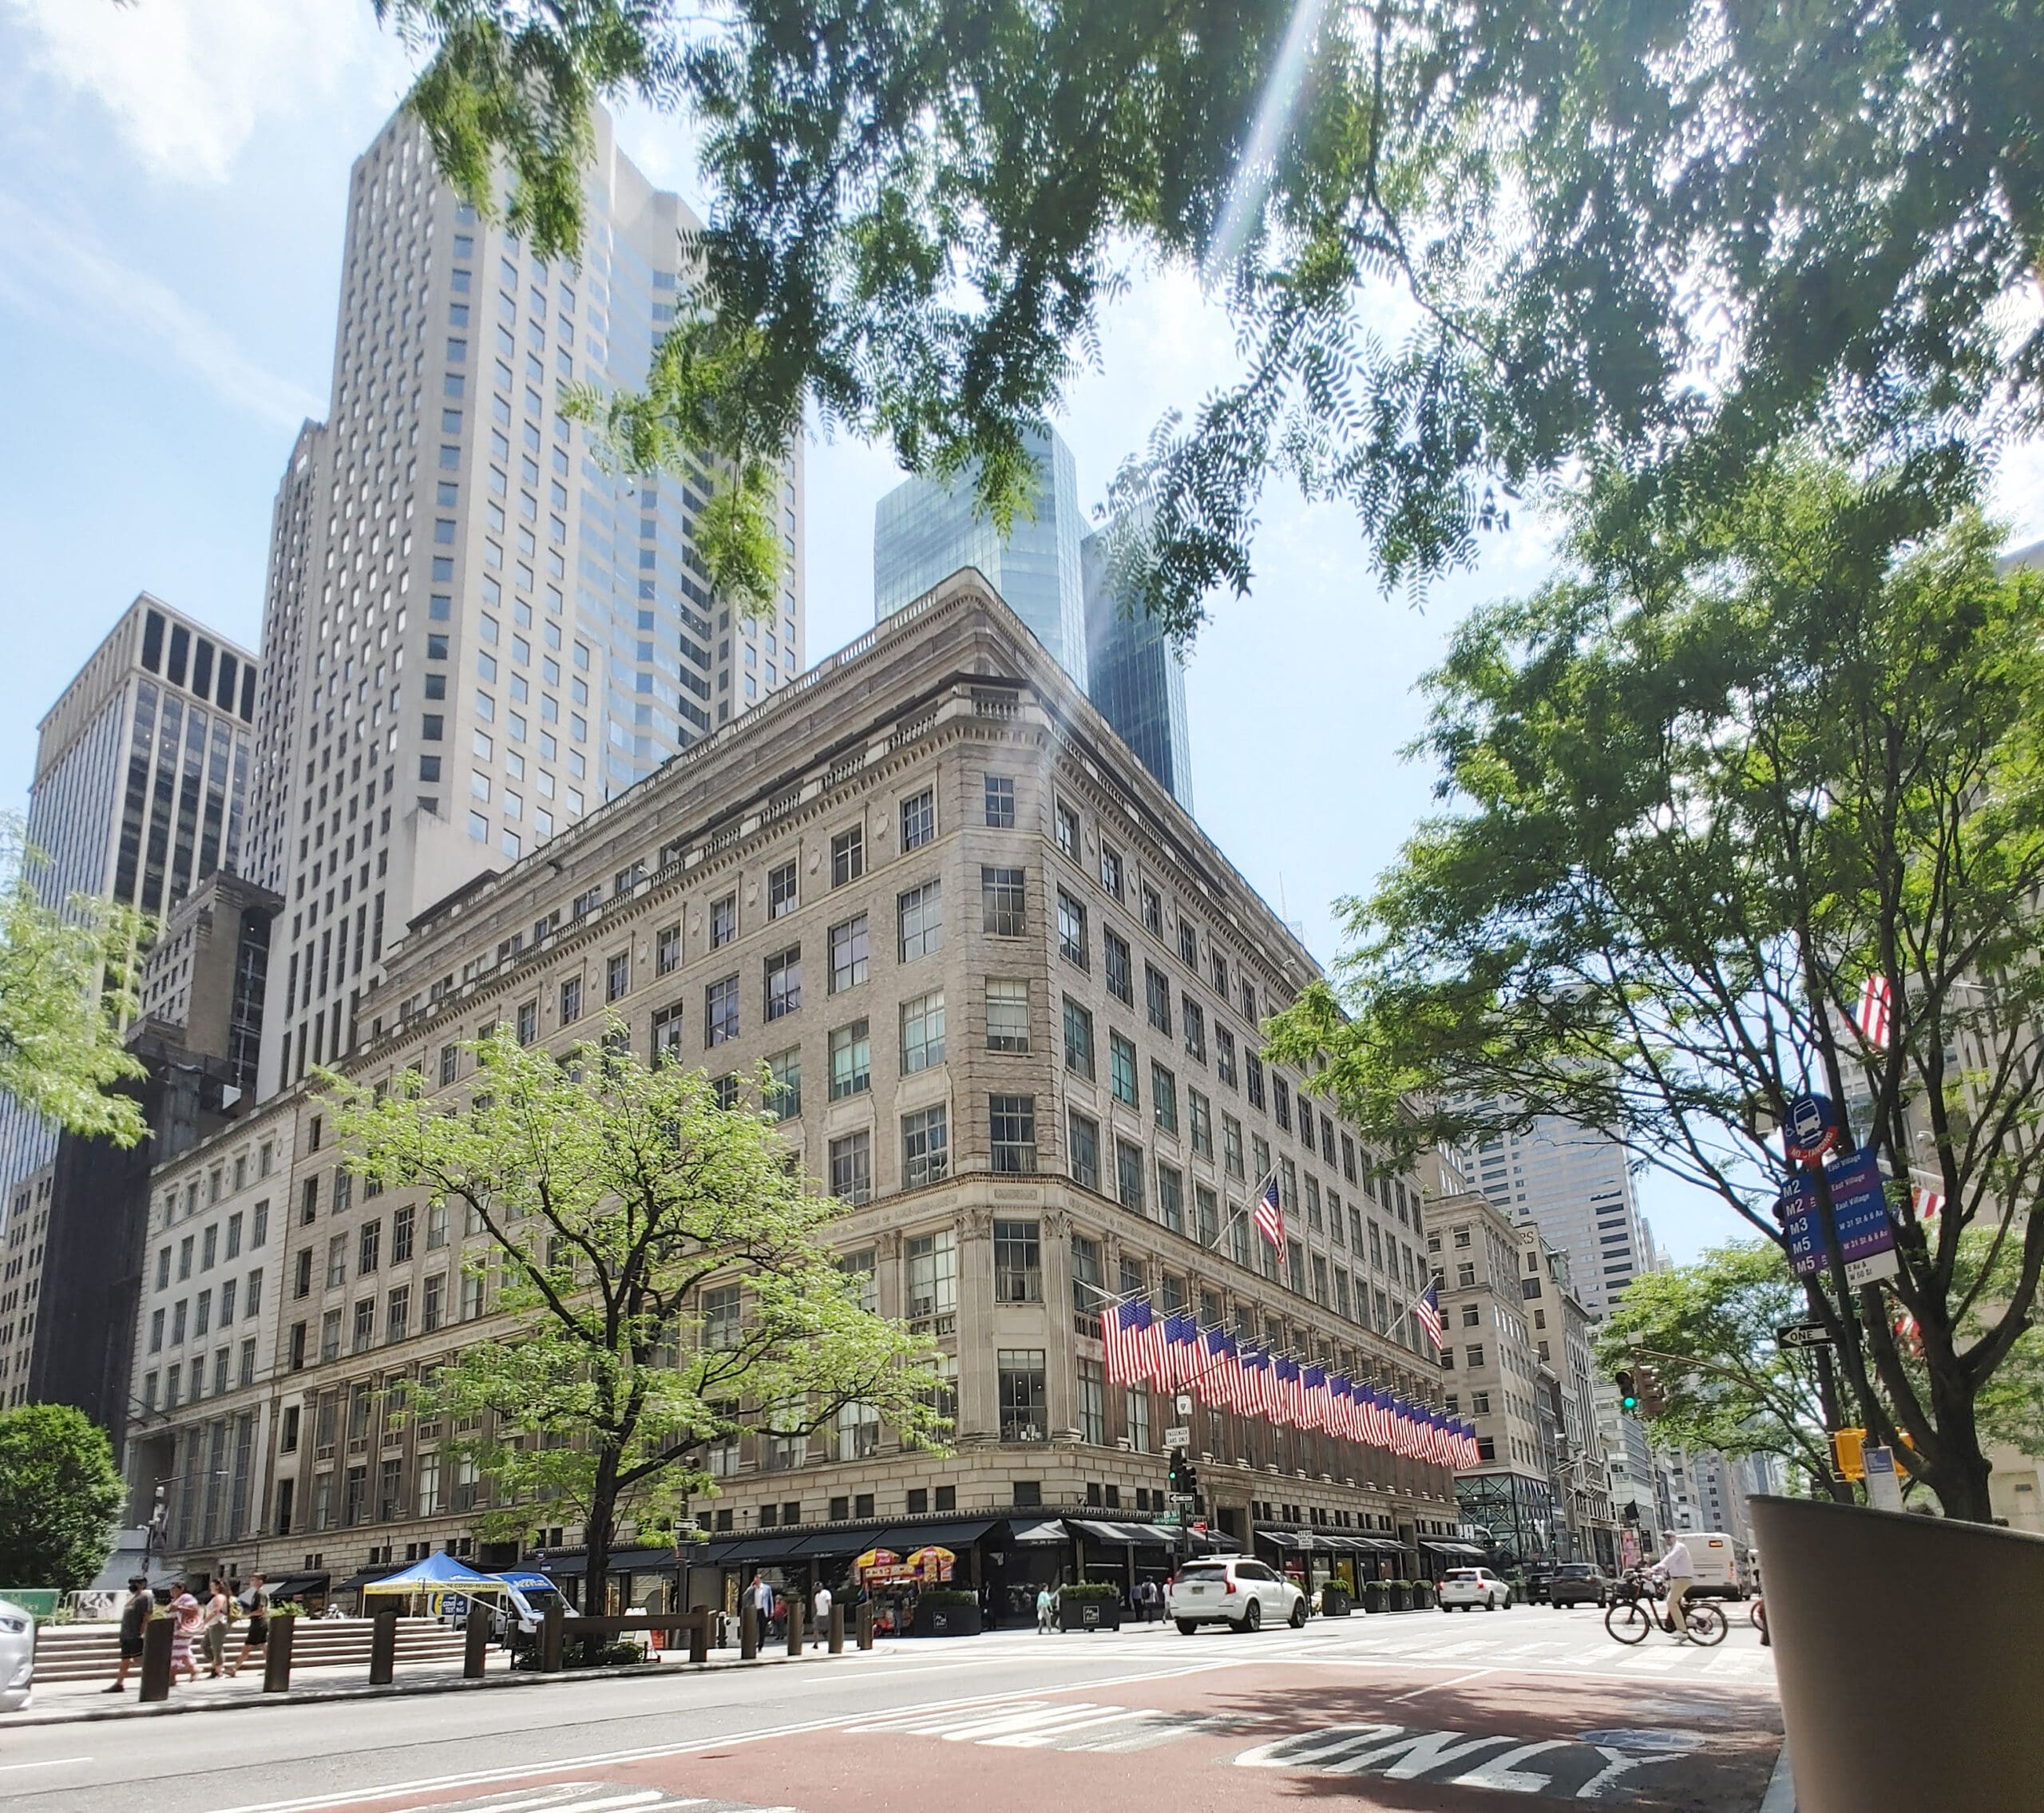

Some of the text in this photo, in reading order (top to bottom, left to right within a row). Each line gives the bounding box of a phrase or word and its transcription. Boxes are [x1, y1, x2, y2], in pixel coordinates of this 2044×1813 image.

[1783, 1179, 1801, 1197] M2
[1786, 1198, 1804, 1217] M2
[1789, 1217, 1808, 1235] M3
[1792, 1236, 1811, 1255] M5
[1796, 1255, 1815, 1273] M5
[1853, 1295, 1862, 1309] 5
[1790, 1331, 1815, 1341] ONE
[1233, 1724, 1690, 1798] ONLY
